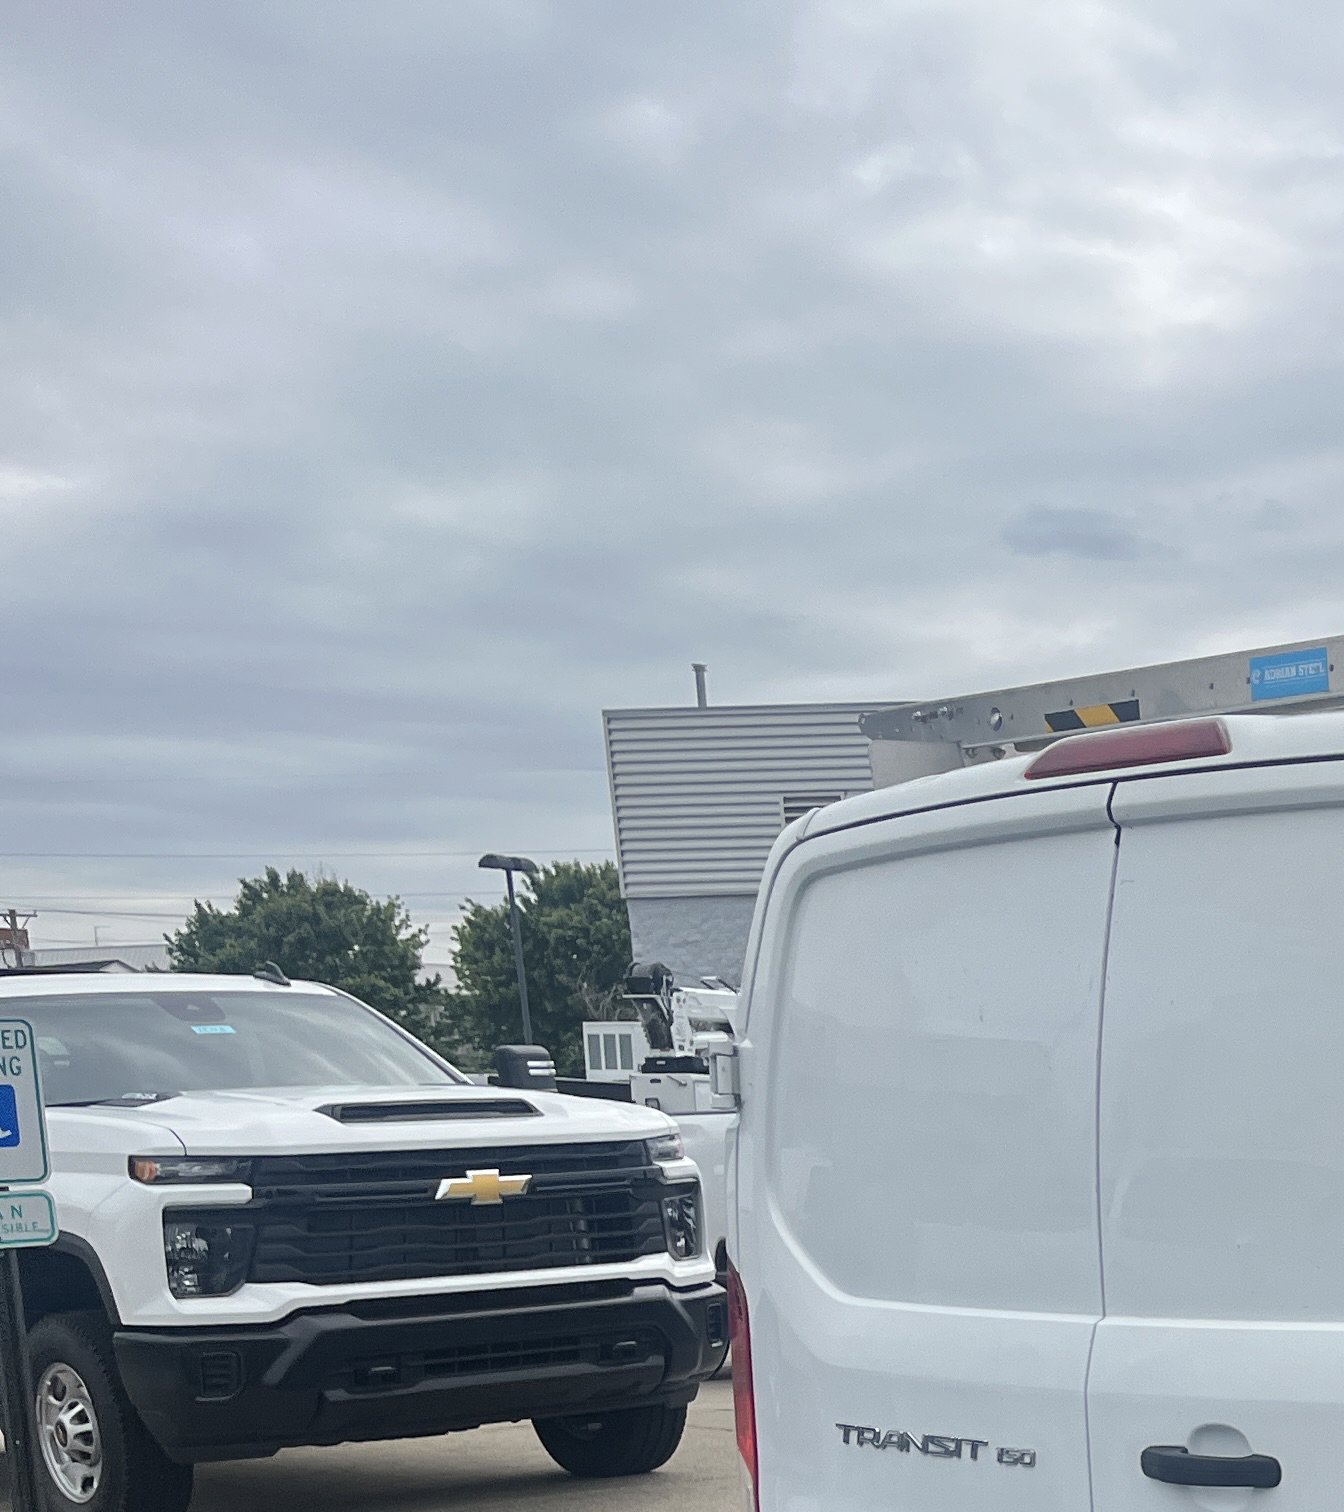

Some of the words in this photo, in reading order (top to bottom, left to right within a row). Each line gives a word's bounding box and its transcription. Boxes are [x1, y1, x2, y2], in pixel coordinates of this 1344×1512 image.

[1, 1029, 27, 1050] ED
[835, 1422, 989, 1461] TRANSIT
[996, 1447, 1036, 1468] 150
